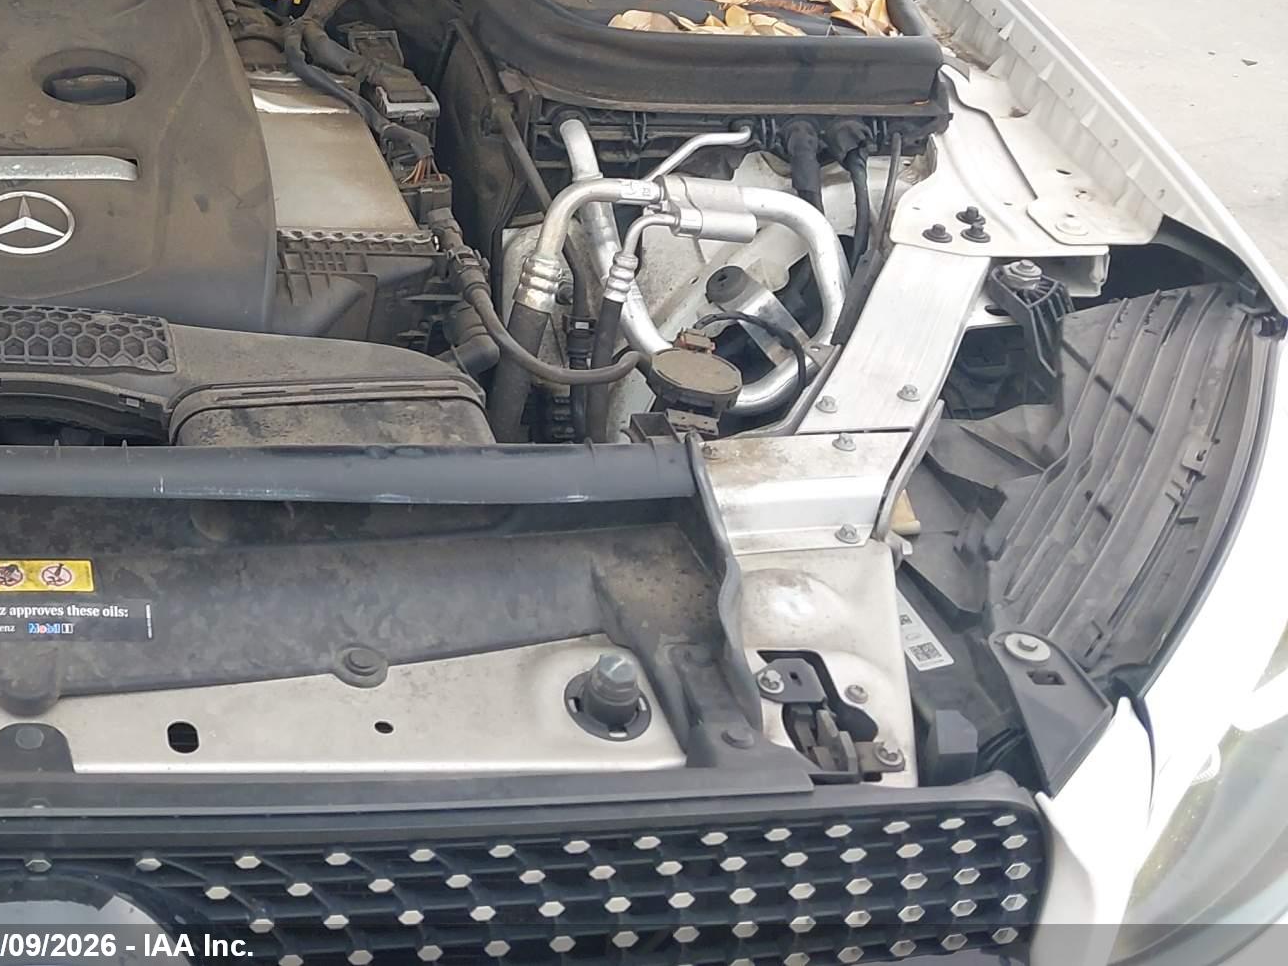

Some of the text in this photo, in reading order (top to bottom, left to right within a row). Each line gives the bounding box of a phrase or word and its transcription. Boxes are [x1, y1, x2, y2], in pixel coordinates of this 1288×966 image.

[9, 607, 64, 619] approves
[67, 605, 99, 617] these
[102, 605, 129, 617] oils:
[27, 622, 61, 634] Mobil
